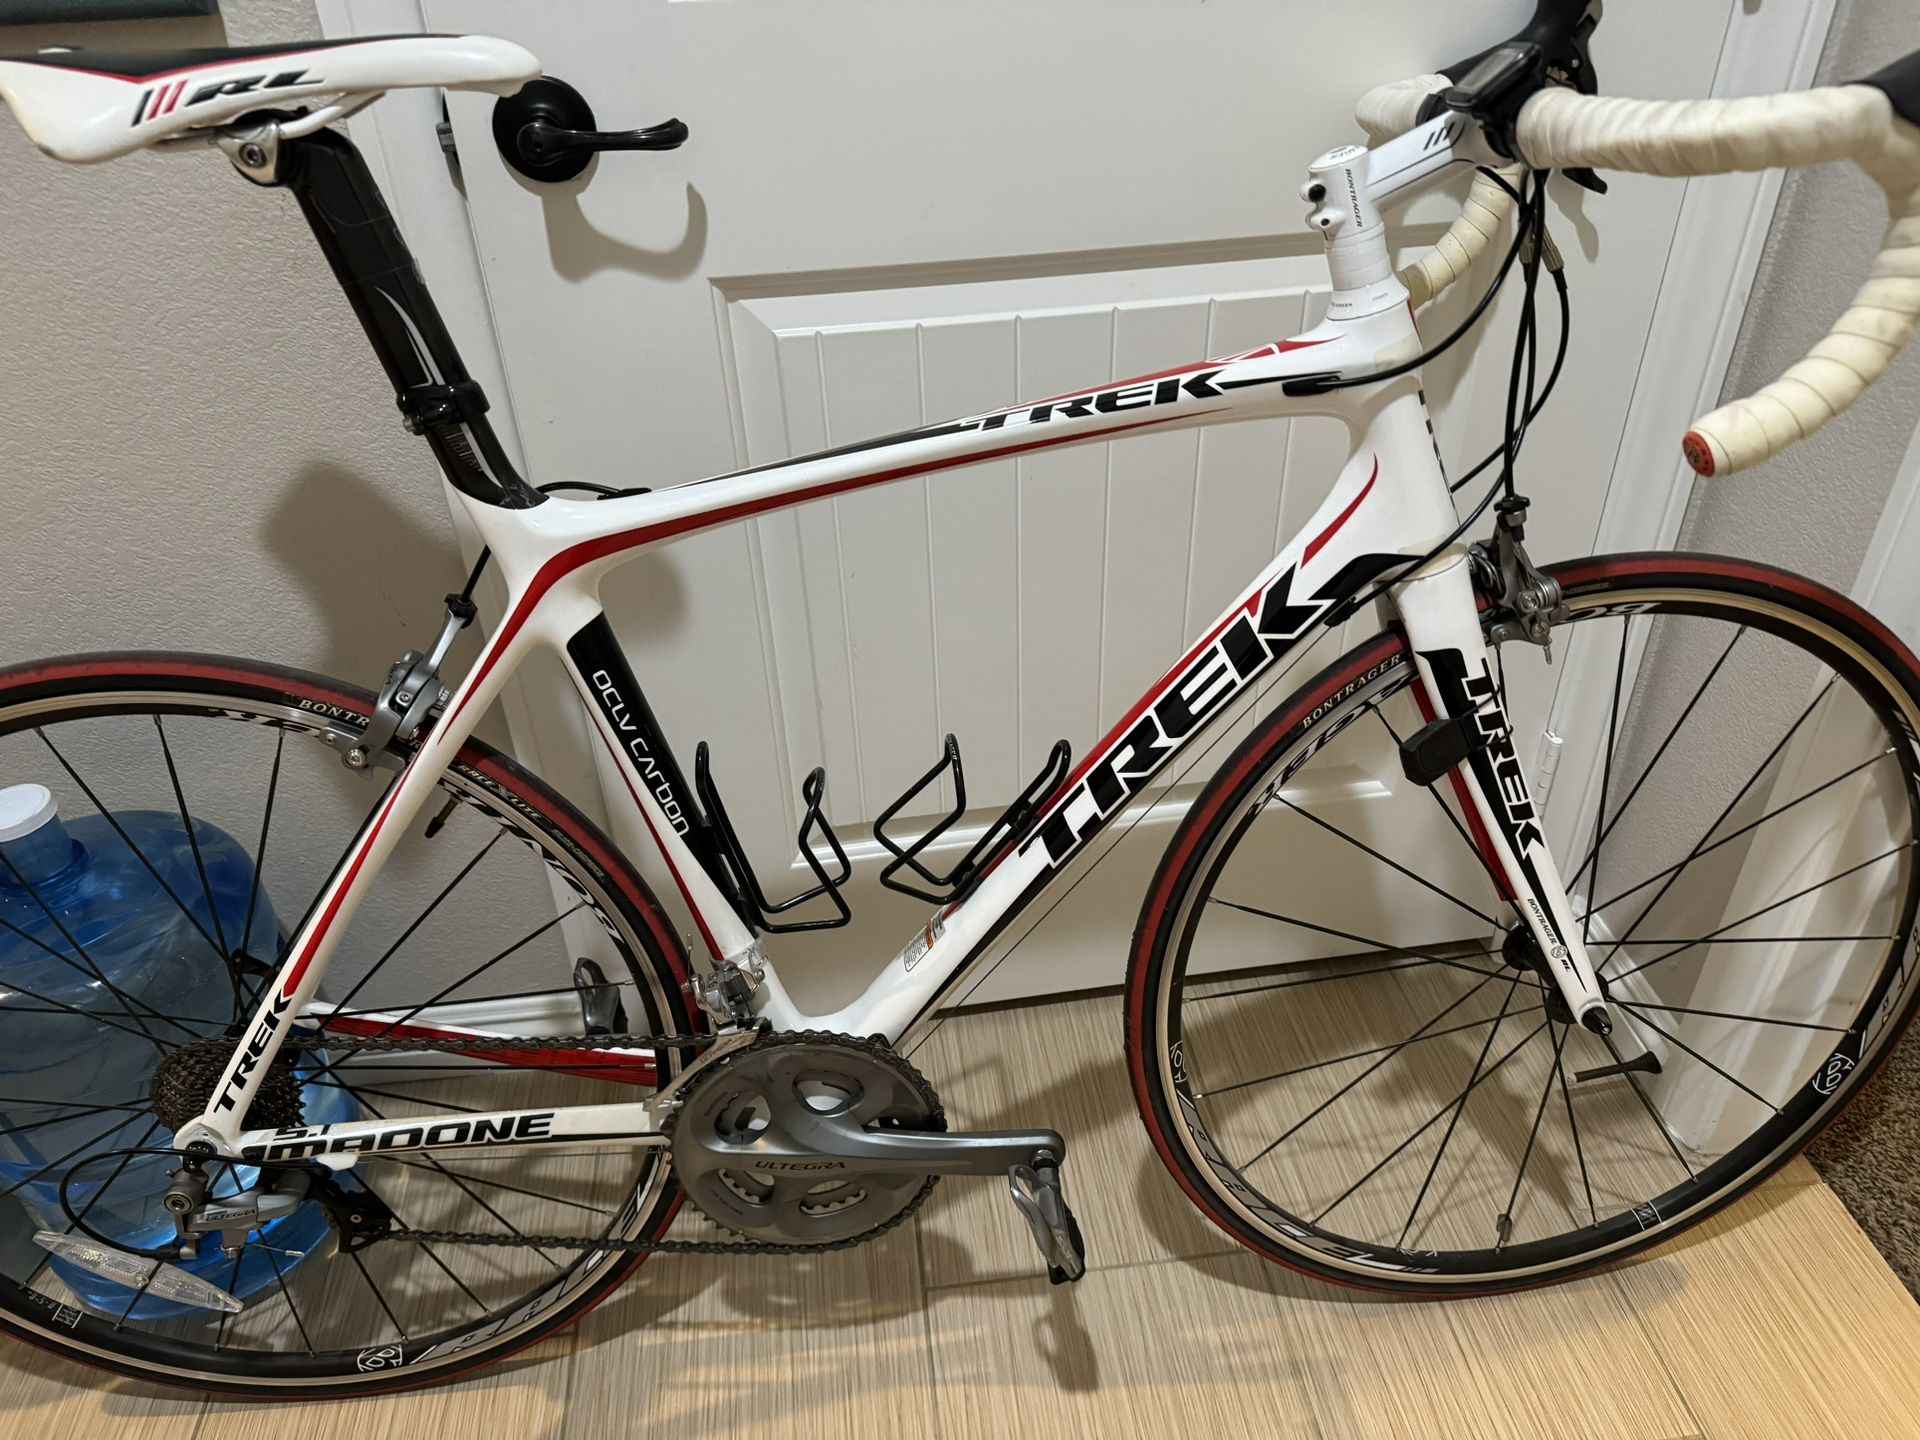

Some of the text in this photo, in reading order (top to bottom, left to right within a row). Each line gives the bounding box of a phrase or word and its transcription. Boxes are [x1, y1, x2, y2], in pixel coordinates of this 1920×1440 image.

[1345, 168, 1363, 228] BONTRAGER
[962, 369, 1224, 431] TREK
[592, 669, 637, 731] OCLV
[1018, 562, 1325, 864] TREK
[1302, 653, 1401, 729] BONTRAGER
[1462, 657, 1546, 860] TREK
[1528, 898, 1558, 946] BONTRAGER
[213, 988, 293, 1113] TREK
[755, 1160, 845, 1171] ULTEGRA
